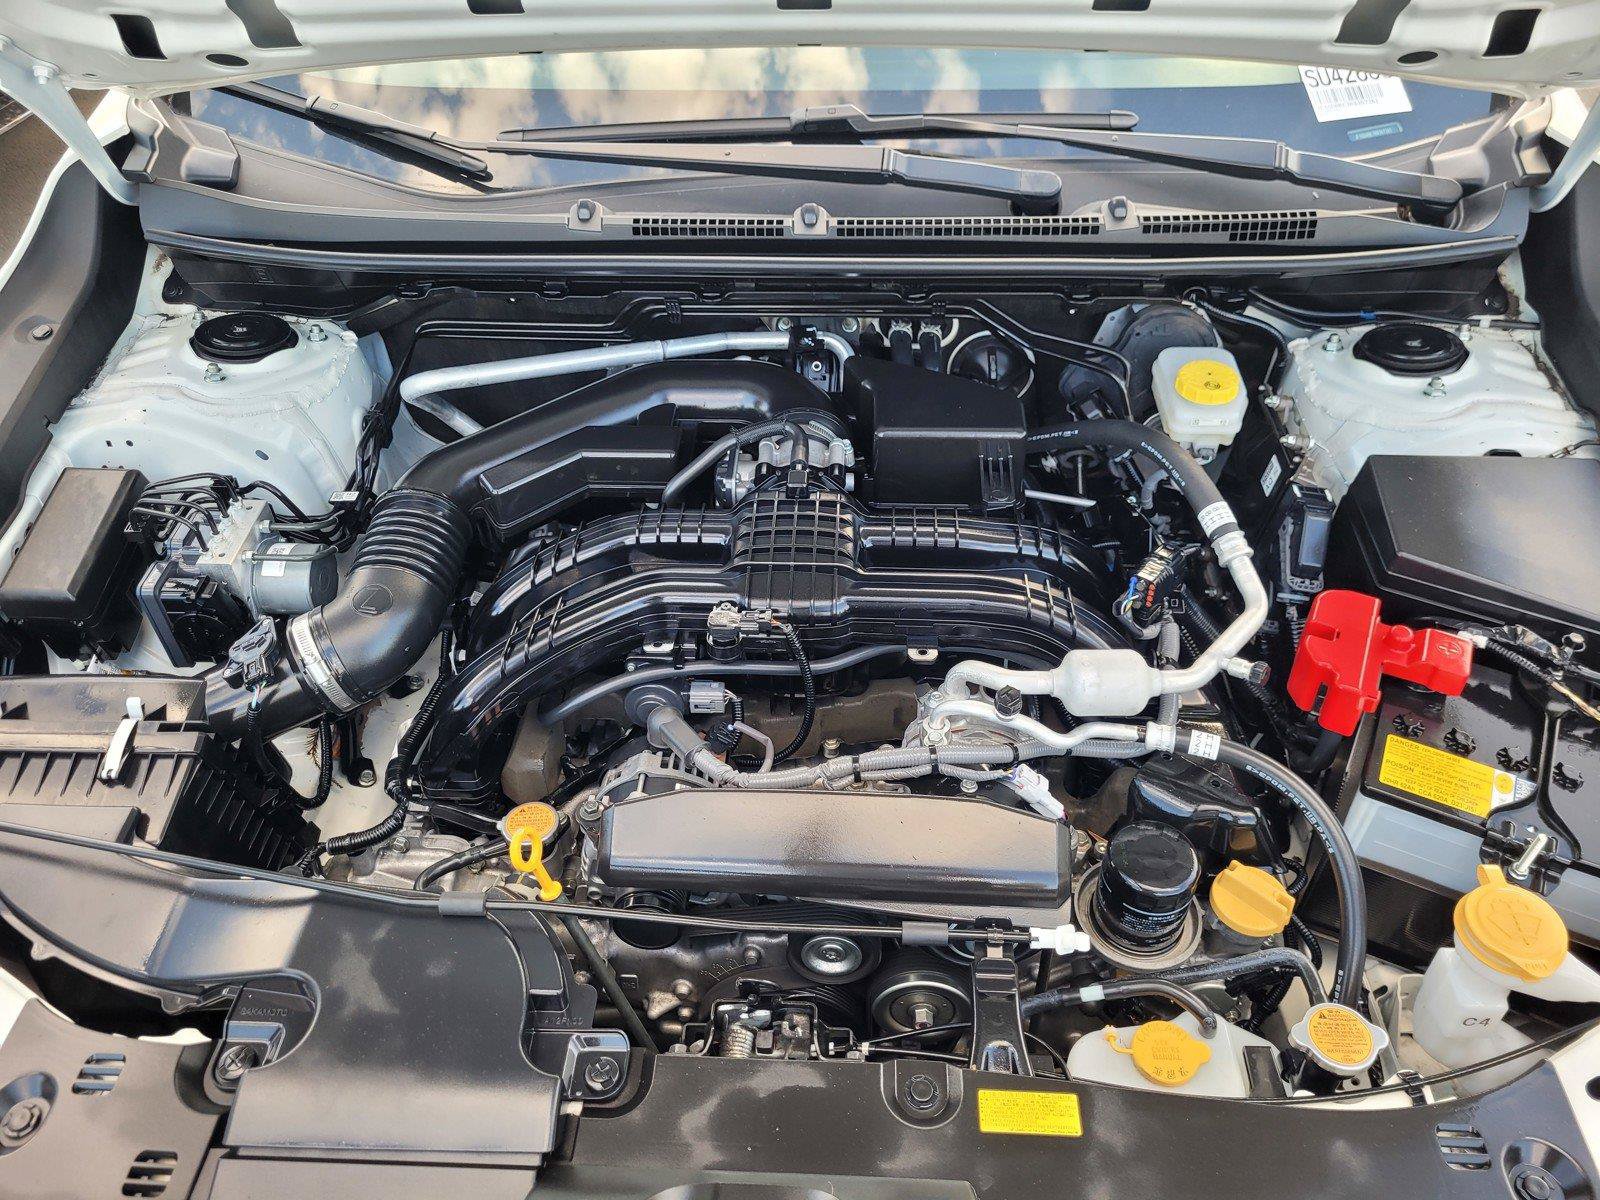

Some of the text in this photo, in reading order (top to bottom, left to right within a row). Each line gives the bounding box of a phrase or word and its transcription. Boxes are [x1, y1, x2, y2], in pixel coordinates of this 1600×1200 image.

[1389, 736, 1419, 750] DANGER
[1385, 759, 1414, 772] POISON
[1463, 1017, 1491, 1026] C4
